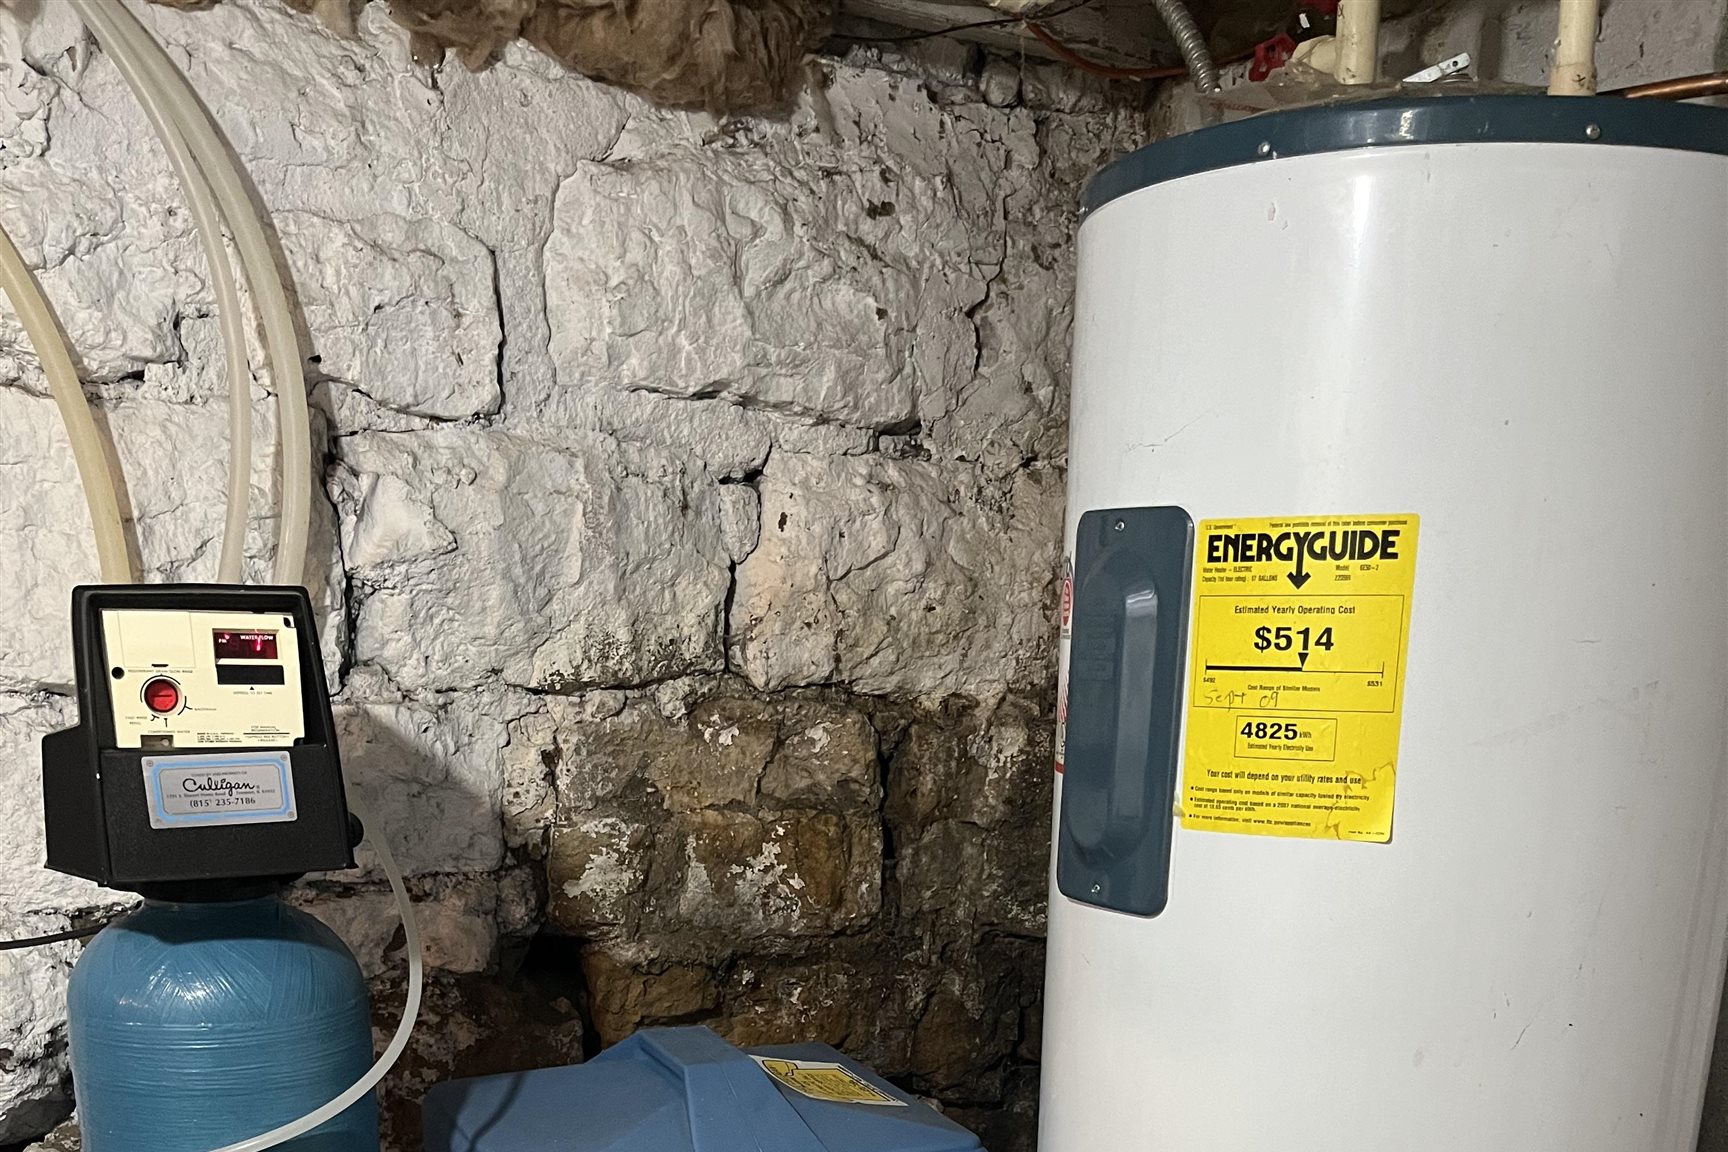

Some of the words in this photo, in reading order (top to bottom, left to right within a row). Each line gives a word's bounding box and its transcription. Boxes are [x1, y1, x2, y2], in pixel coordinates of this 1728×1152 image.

[1207, 530, 1400, 563] ENERGYGUIDE
[1234, 606, 1269, 614] Estimated
[1272, 606, 1295, 614] Yearly
[1298, 606, 1336, 614] Operating
[1338, 606, 1356, 614] Cost
[1254, 626, 1334, 653] $514
[1204, 690, 1247, 712] Sept
[1240, 722, 1298, 740] 4825
[1207, 770, 1219, 778] Your
[1234, 771, 1246, 779] will
[1246, 772, 1270, 782] depend
[1280, 774, 1294, 783] your
[1296, 774, 1315, 784] utility
[1317, 776, 1333, 784] rates
[1335, 776, 1347, 784] and
[182, 777, 255, 797] Culligan
[216, 796, 256, 806] 235-7186
